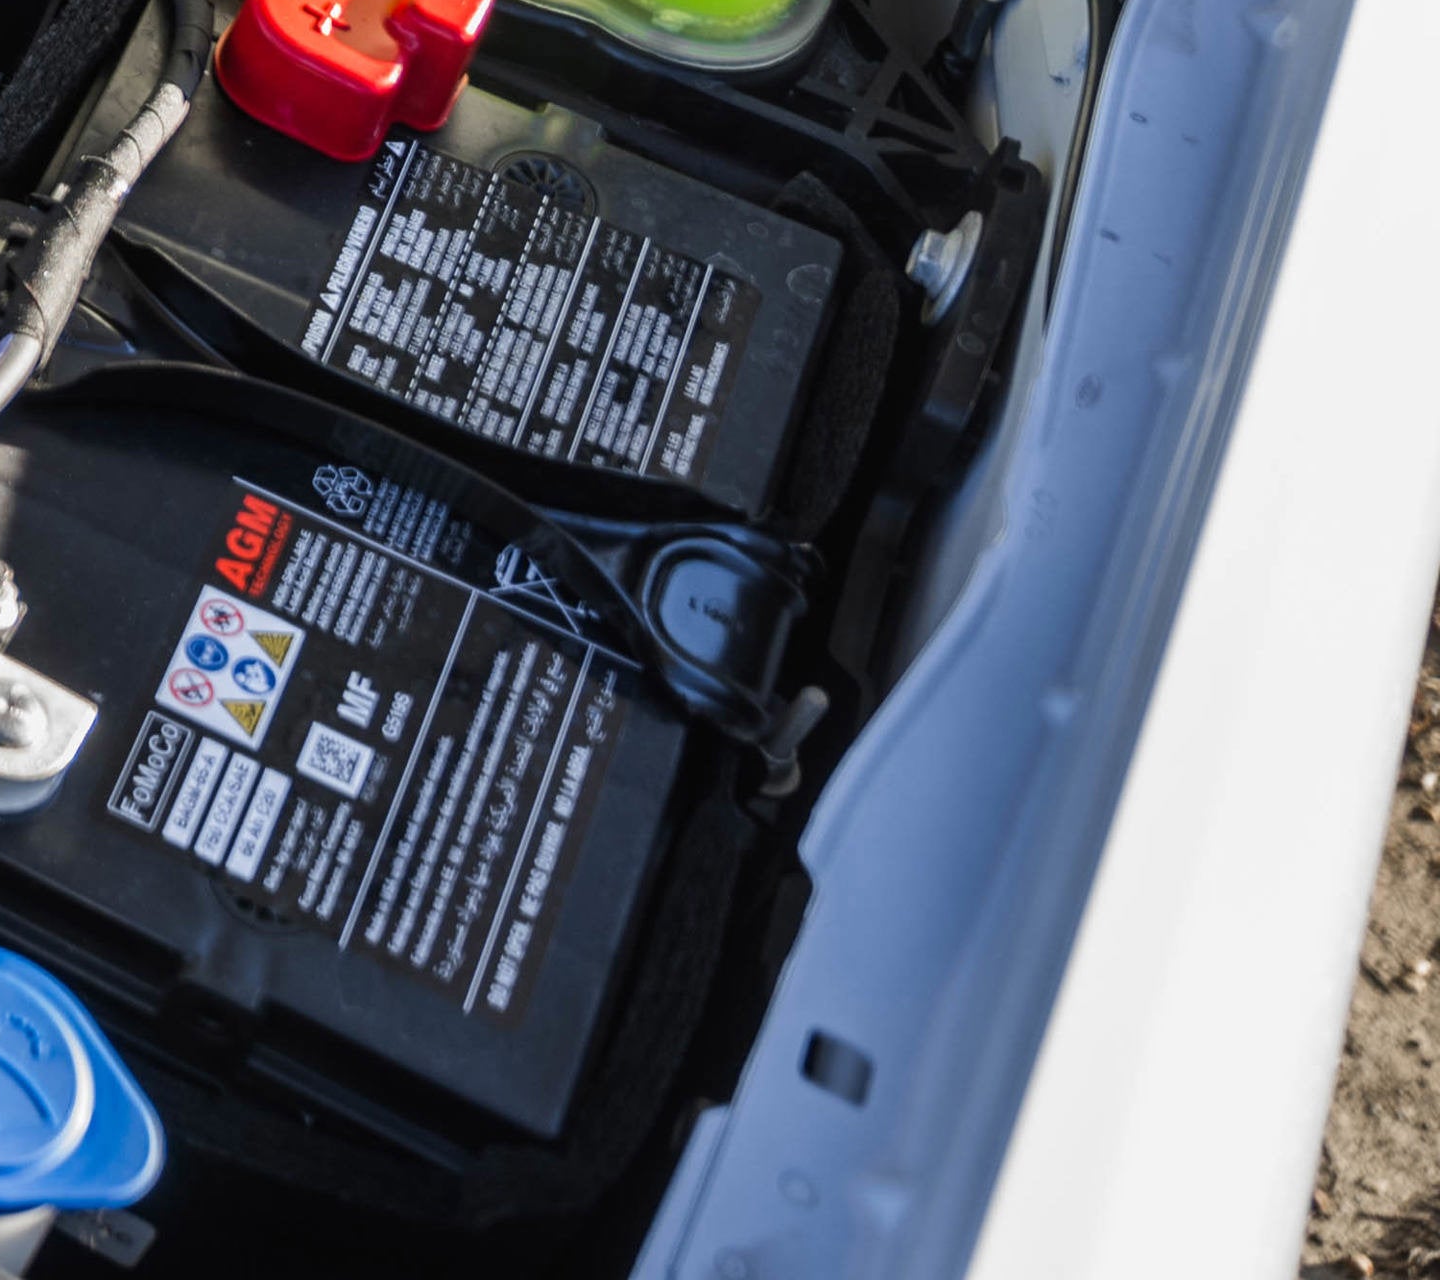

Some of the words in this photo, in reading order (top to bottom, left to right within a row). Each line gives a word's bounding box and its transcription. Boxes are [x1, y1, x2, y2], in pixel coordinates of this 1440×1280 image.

[326, 204, 377, 295] PELIGRO/VENENO
[210, 491, 278, 592] AGM
[334, 669, 384, 728] MF
[118, 718, 182, 820] FoMoCo
[212, 760, 251, 825] CCA/SAE
